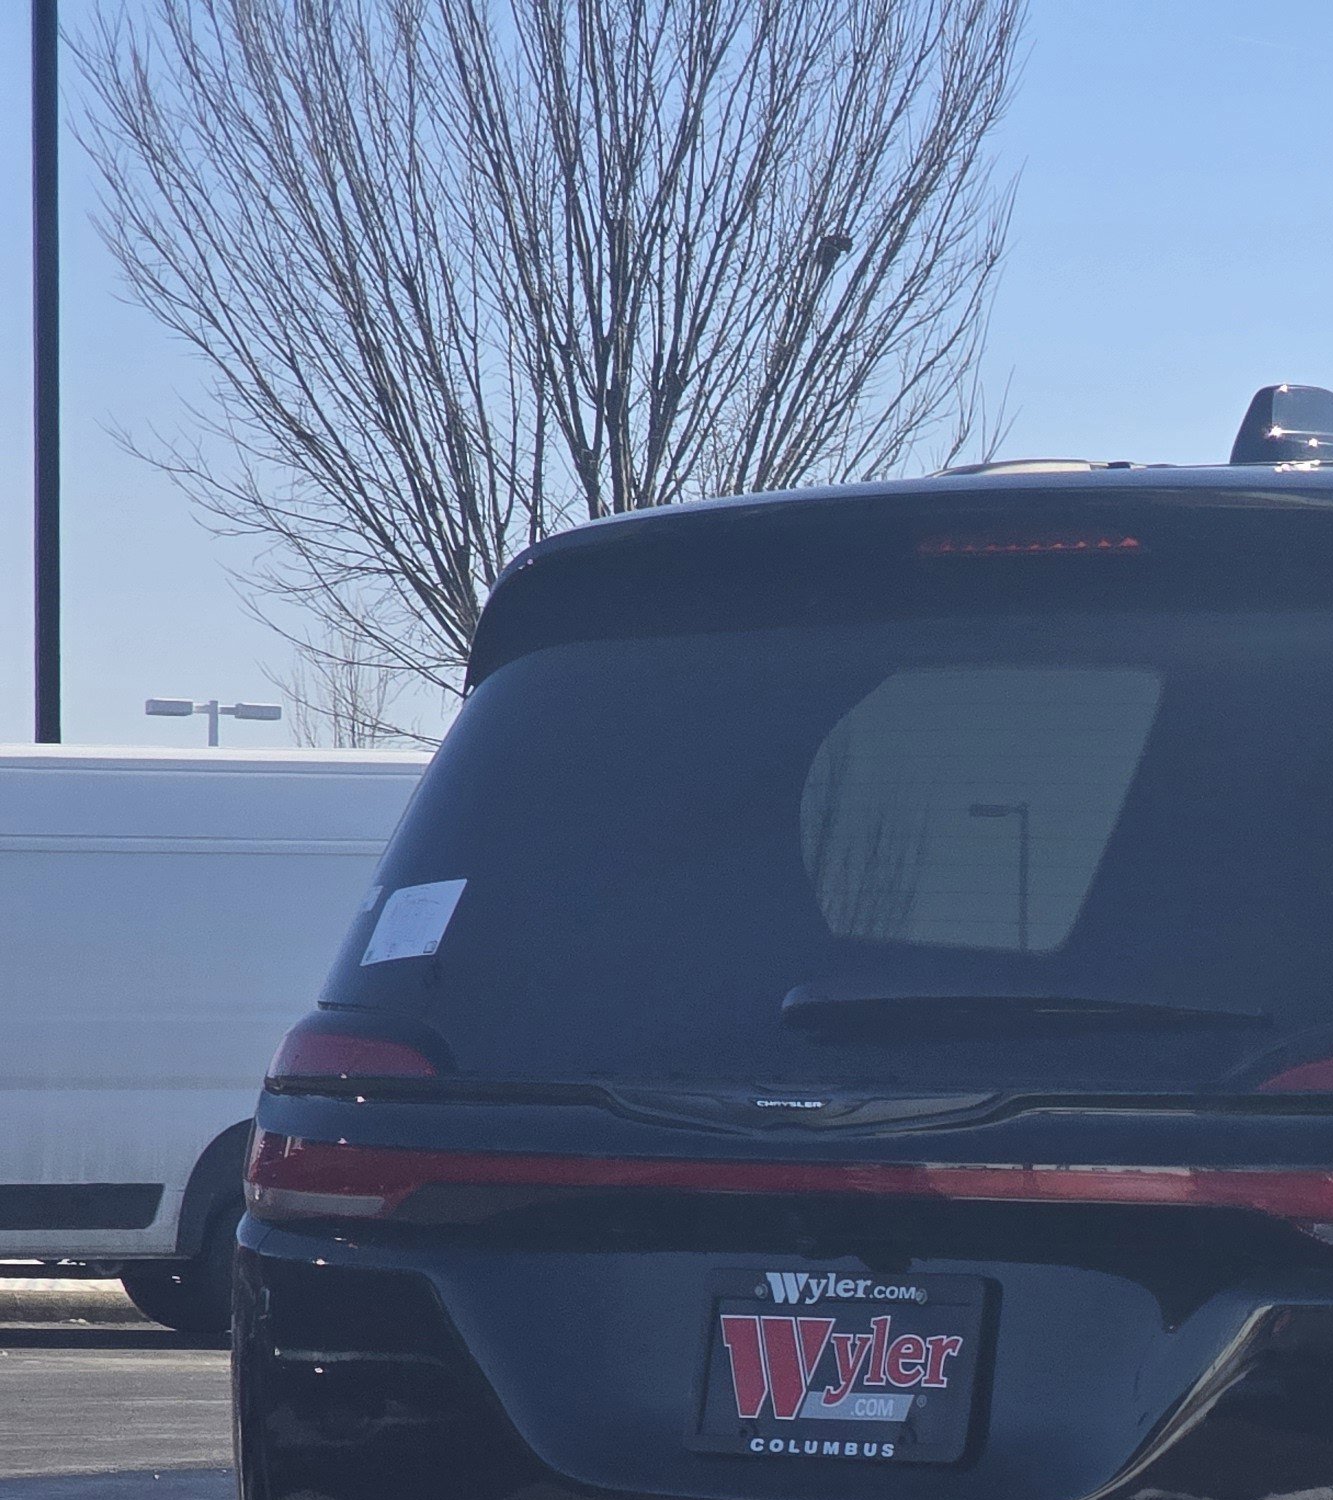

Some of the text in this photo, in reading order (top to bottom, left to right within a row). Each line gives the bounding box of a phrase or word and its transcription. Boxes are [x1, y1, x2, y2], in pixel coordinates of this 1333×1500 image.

[756, 1099, 823, 1109] CHRYSLER
[720, 1314, 963, 1420] Wyler
[850, 1399, 893, 1417] .COM
[750, 1438, 895, 1457] COLUMBUS
